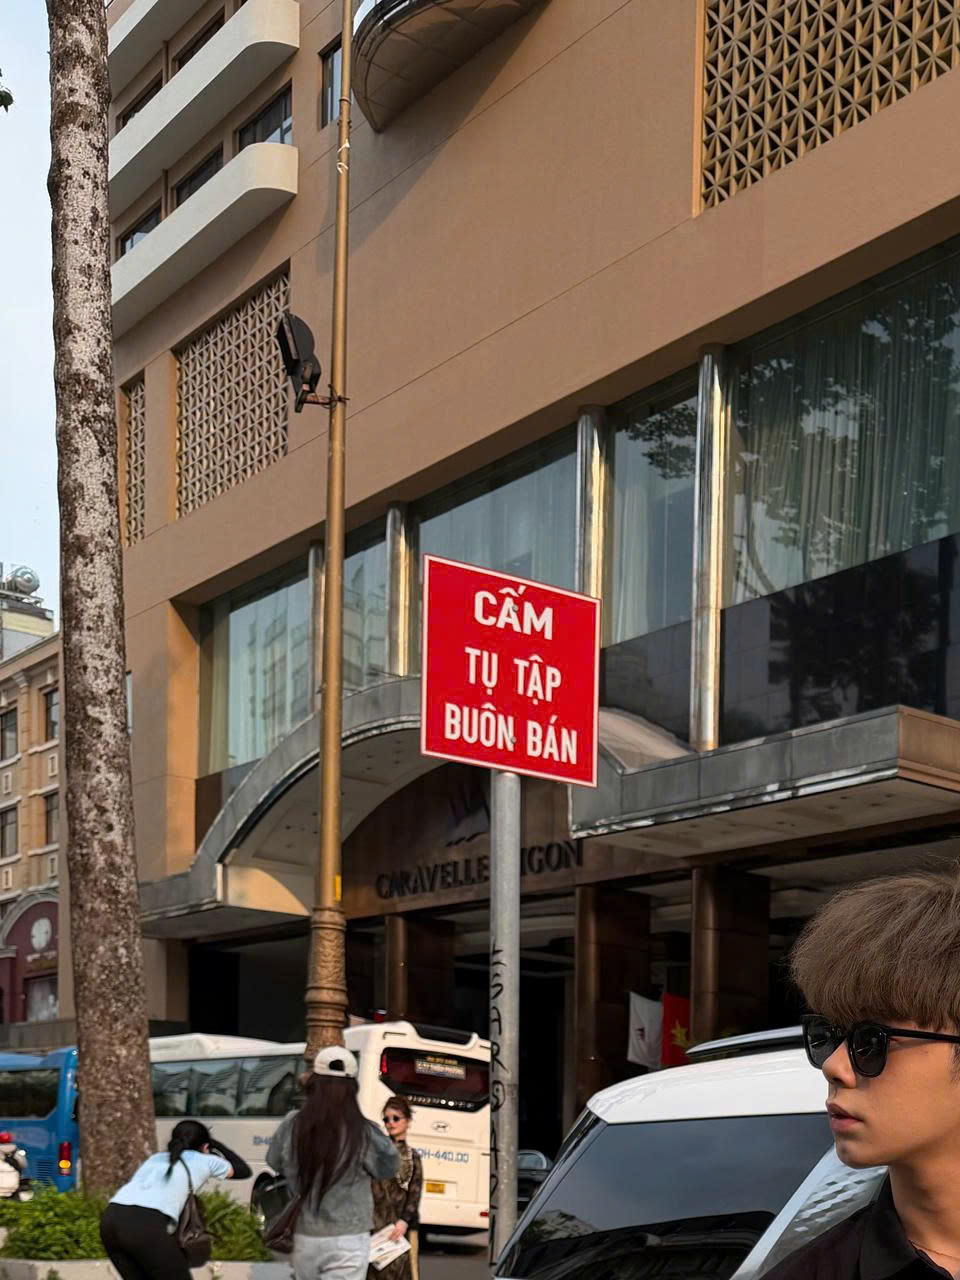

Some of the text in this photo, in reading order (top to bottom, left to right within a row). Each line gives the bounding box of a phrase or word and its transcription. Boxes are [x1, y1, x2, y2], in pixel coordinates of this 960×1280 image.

[474, 585, 553, 640] CẤM
[464, 646, 562, 705] TỤ TẬP
[444, 702, 578, 764] BUÔN BÁN
[375, 838, 584, 899] CARAVELLE IGON
